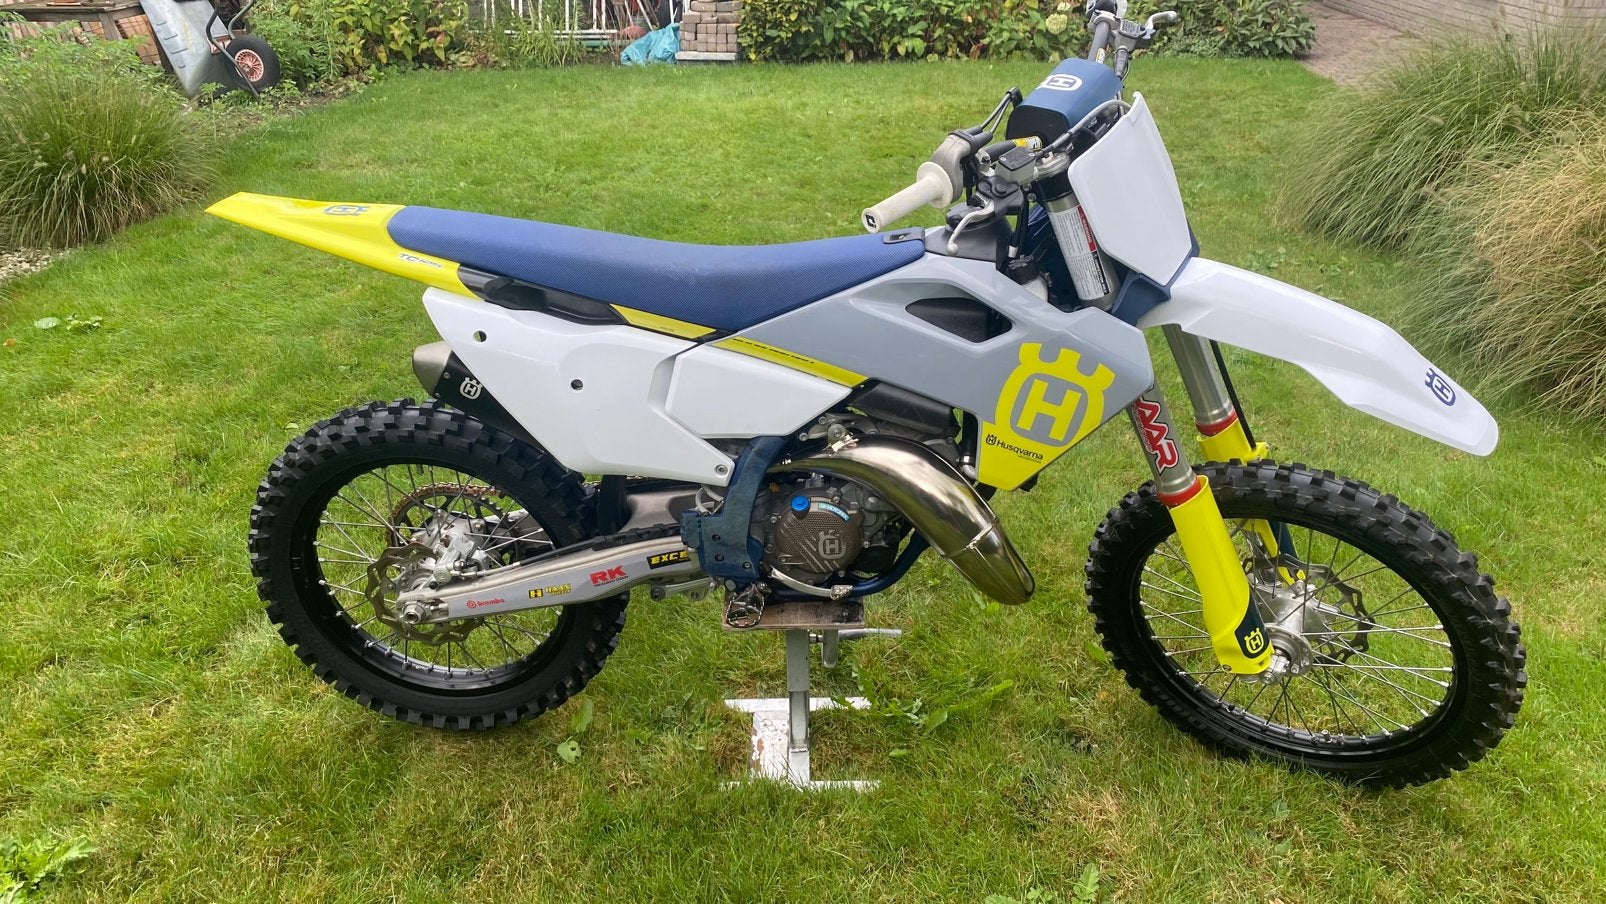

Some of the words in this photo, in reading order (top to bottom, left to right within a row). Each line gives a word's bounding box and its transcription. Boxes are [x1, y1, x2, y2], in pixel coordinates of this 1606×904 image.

[996, 440, 1044, 461] Husqvarna
[590, 565, 626, 584] RK
[477, 597, 505, 607] brembo
